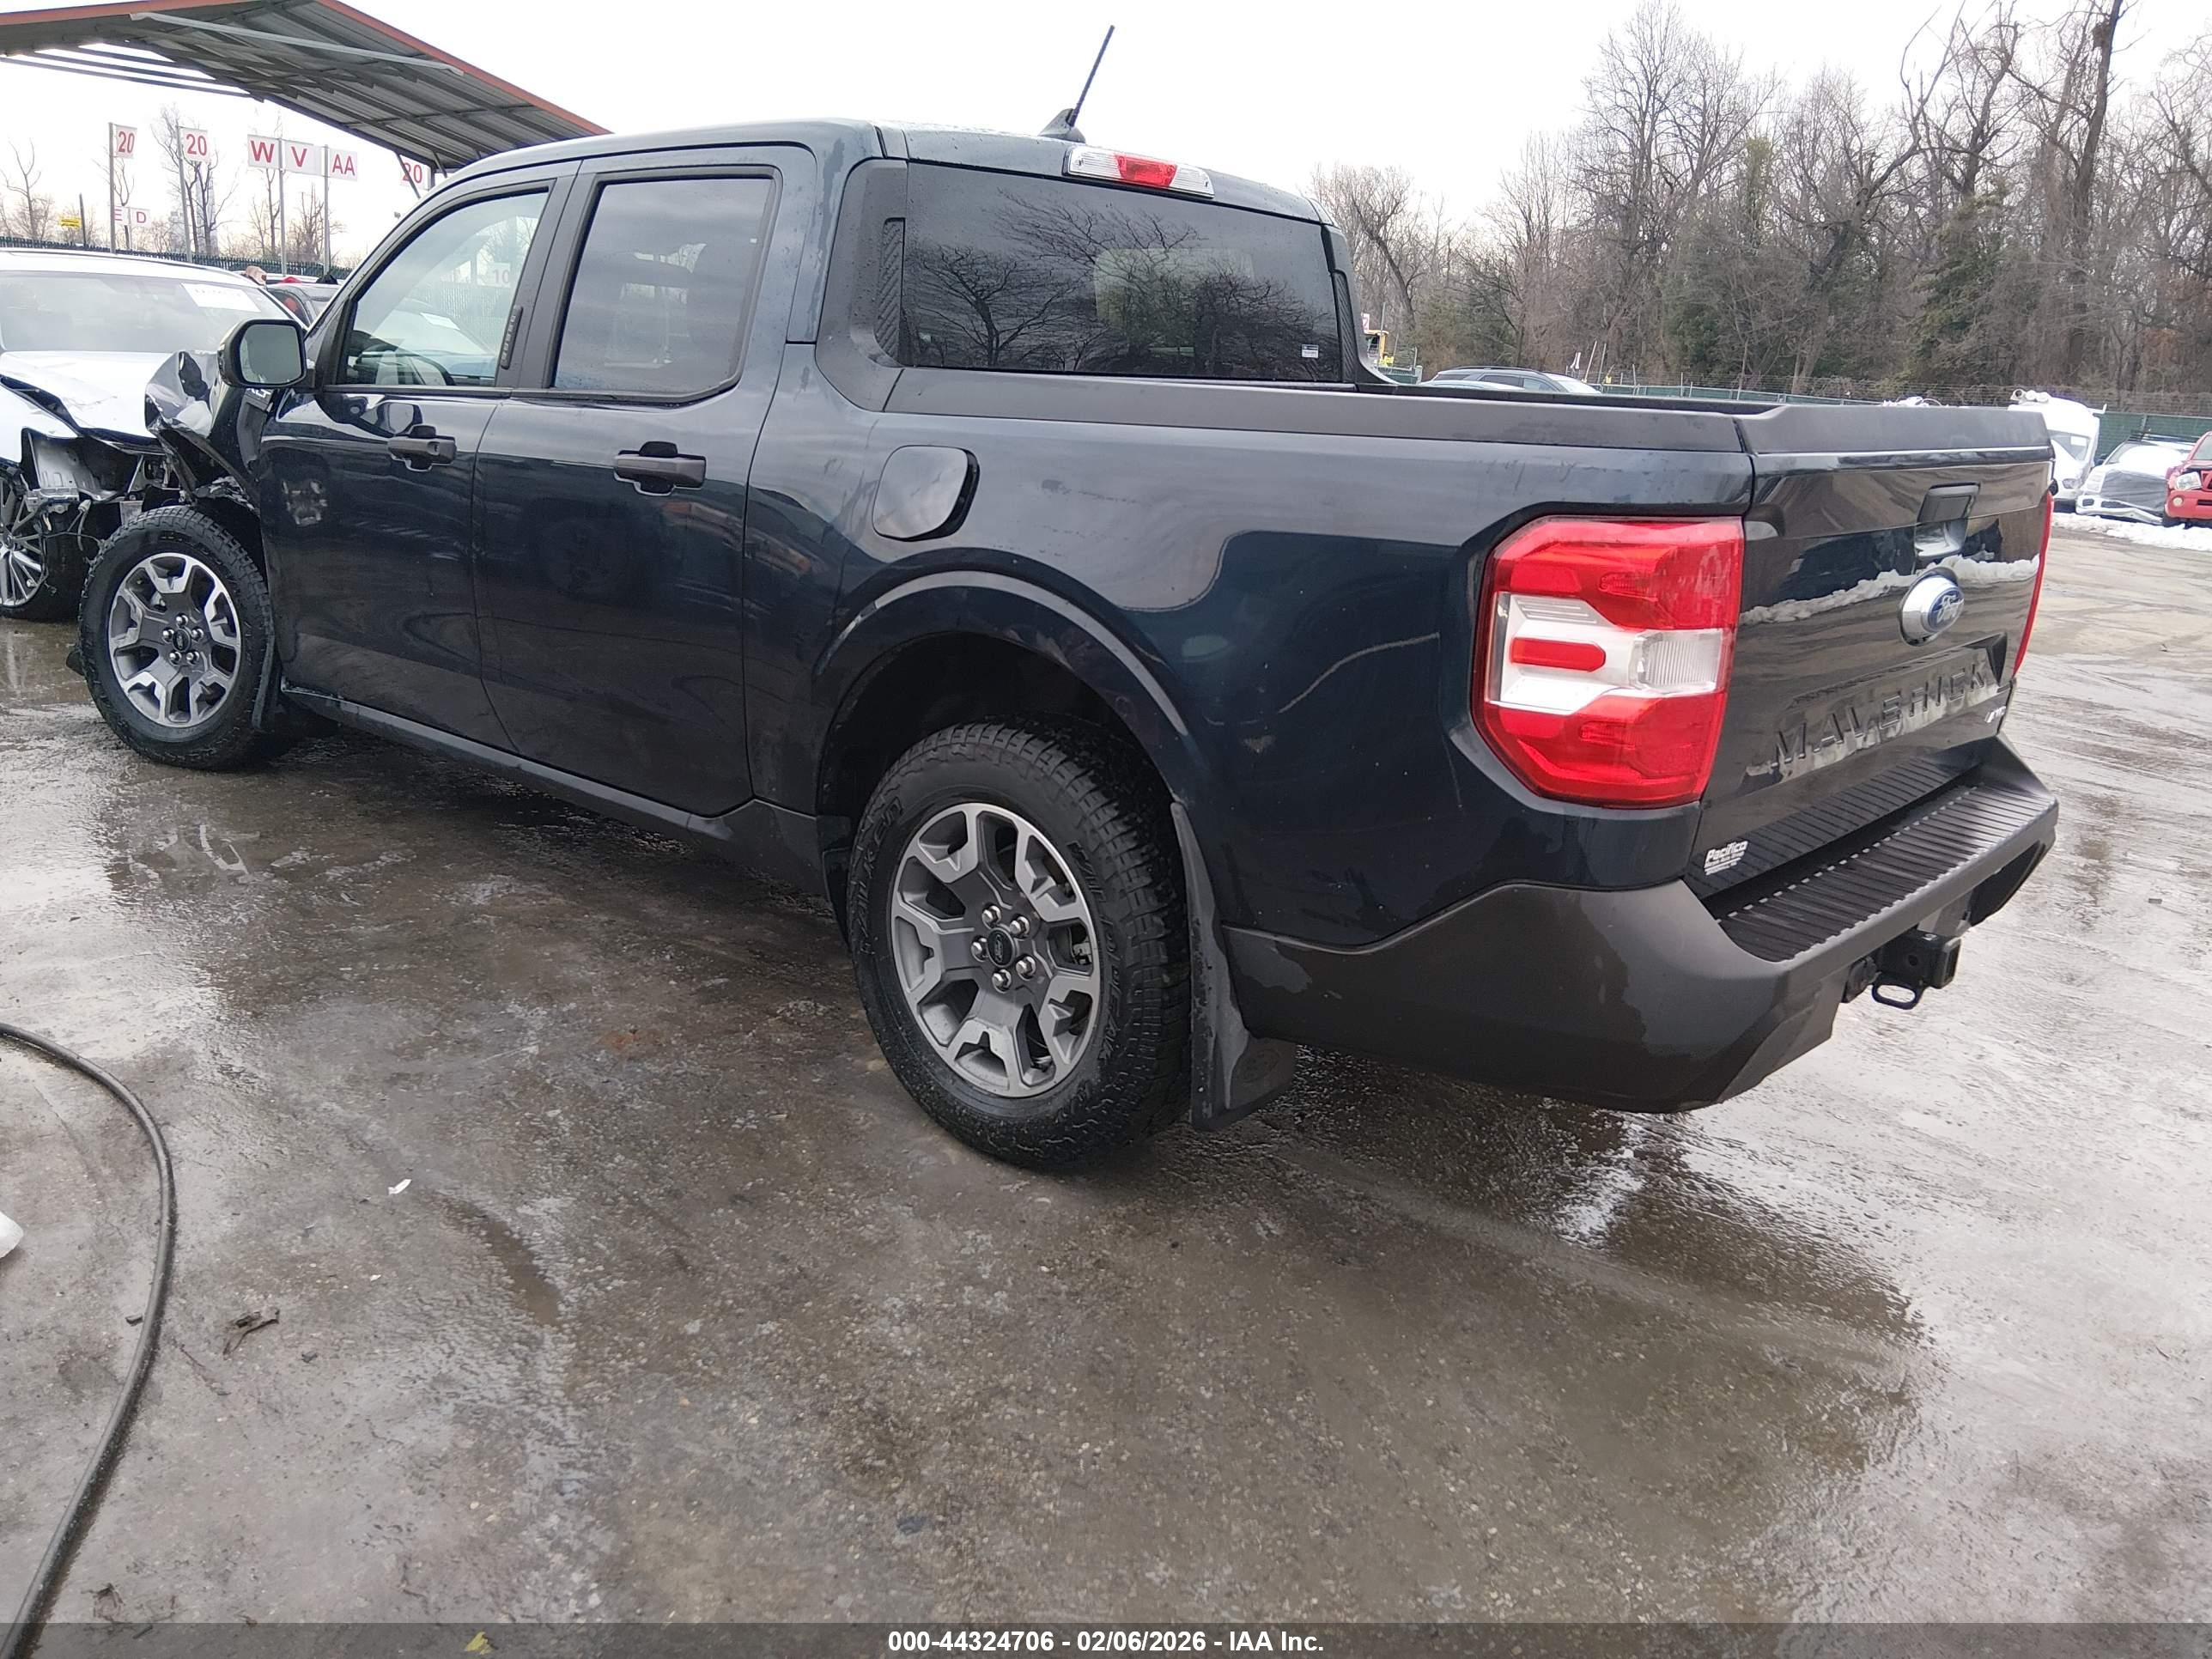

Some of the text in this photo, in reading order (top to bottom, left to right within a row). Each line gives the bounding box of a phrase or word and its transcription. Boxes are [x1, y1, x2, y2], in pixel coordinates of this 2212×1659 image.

[118, 131, 135, 154] 20
[185, 133, 208, 155] 20
[250, 140, 275, 163] W
[291, 146, 307, 167] V
[331, 154, 356, 176] AA
[402, 162, 422, 184] 20
[137, 211, 146, 223] D
[494, 269, 509, 284] 10
